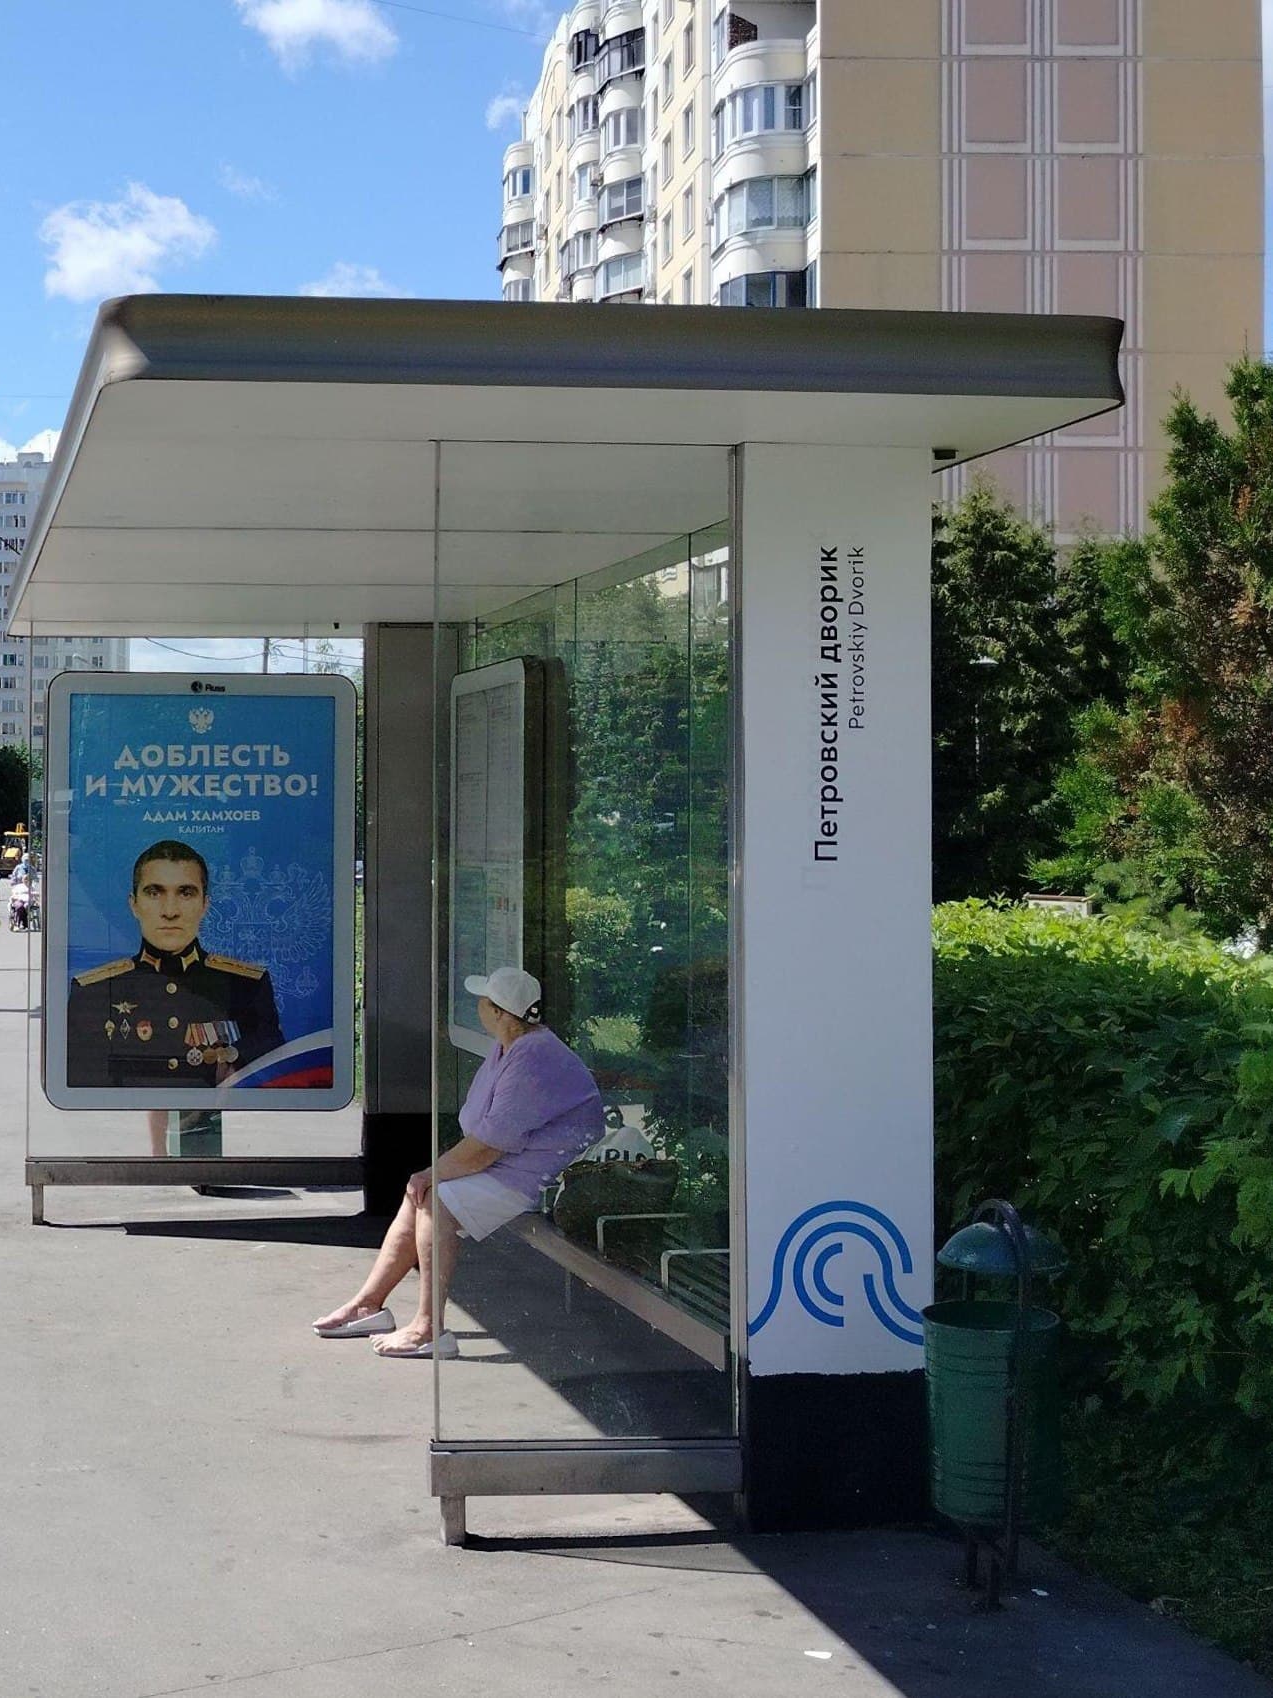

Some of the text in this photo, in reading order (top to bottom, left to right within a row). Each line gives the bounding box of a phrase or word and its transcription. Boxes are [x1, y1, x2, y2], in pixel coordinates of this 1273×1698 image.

[847, 547, 868, 729] Petrovskiy Dvorik
[814, 546, 844, 862] Петровский дворик
[114, 744, 290, 770] ДОБЛЕСТЬ
[85, 774, 319, 798] И МУЖЕСТВО!
[142, 809, 261, 823] АДАМ ХАМХОЕВ
[178, 825, 226, 835] КАПИТАН
